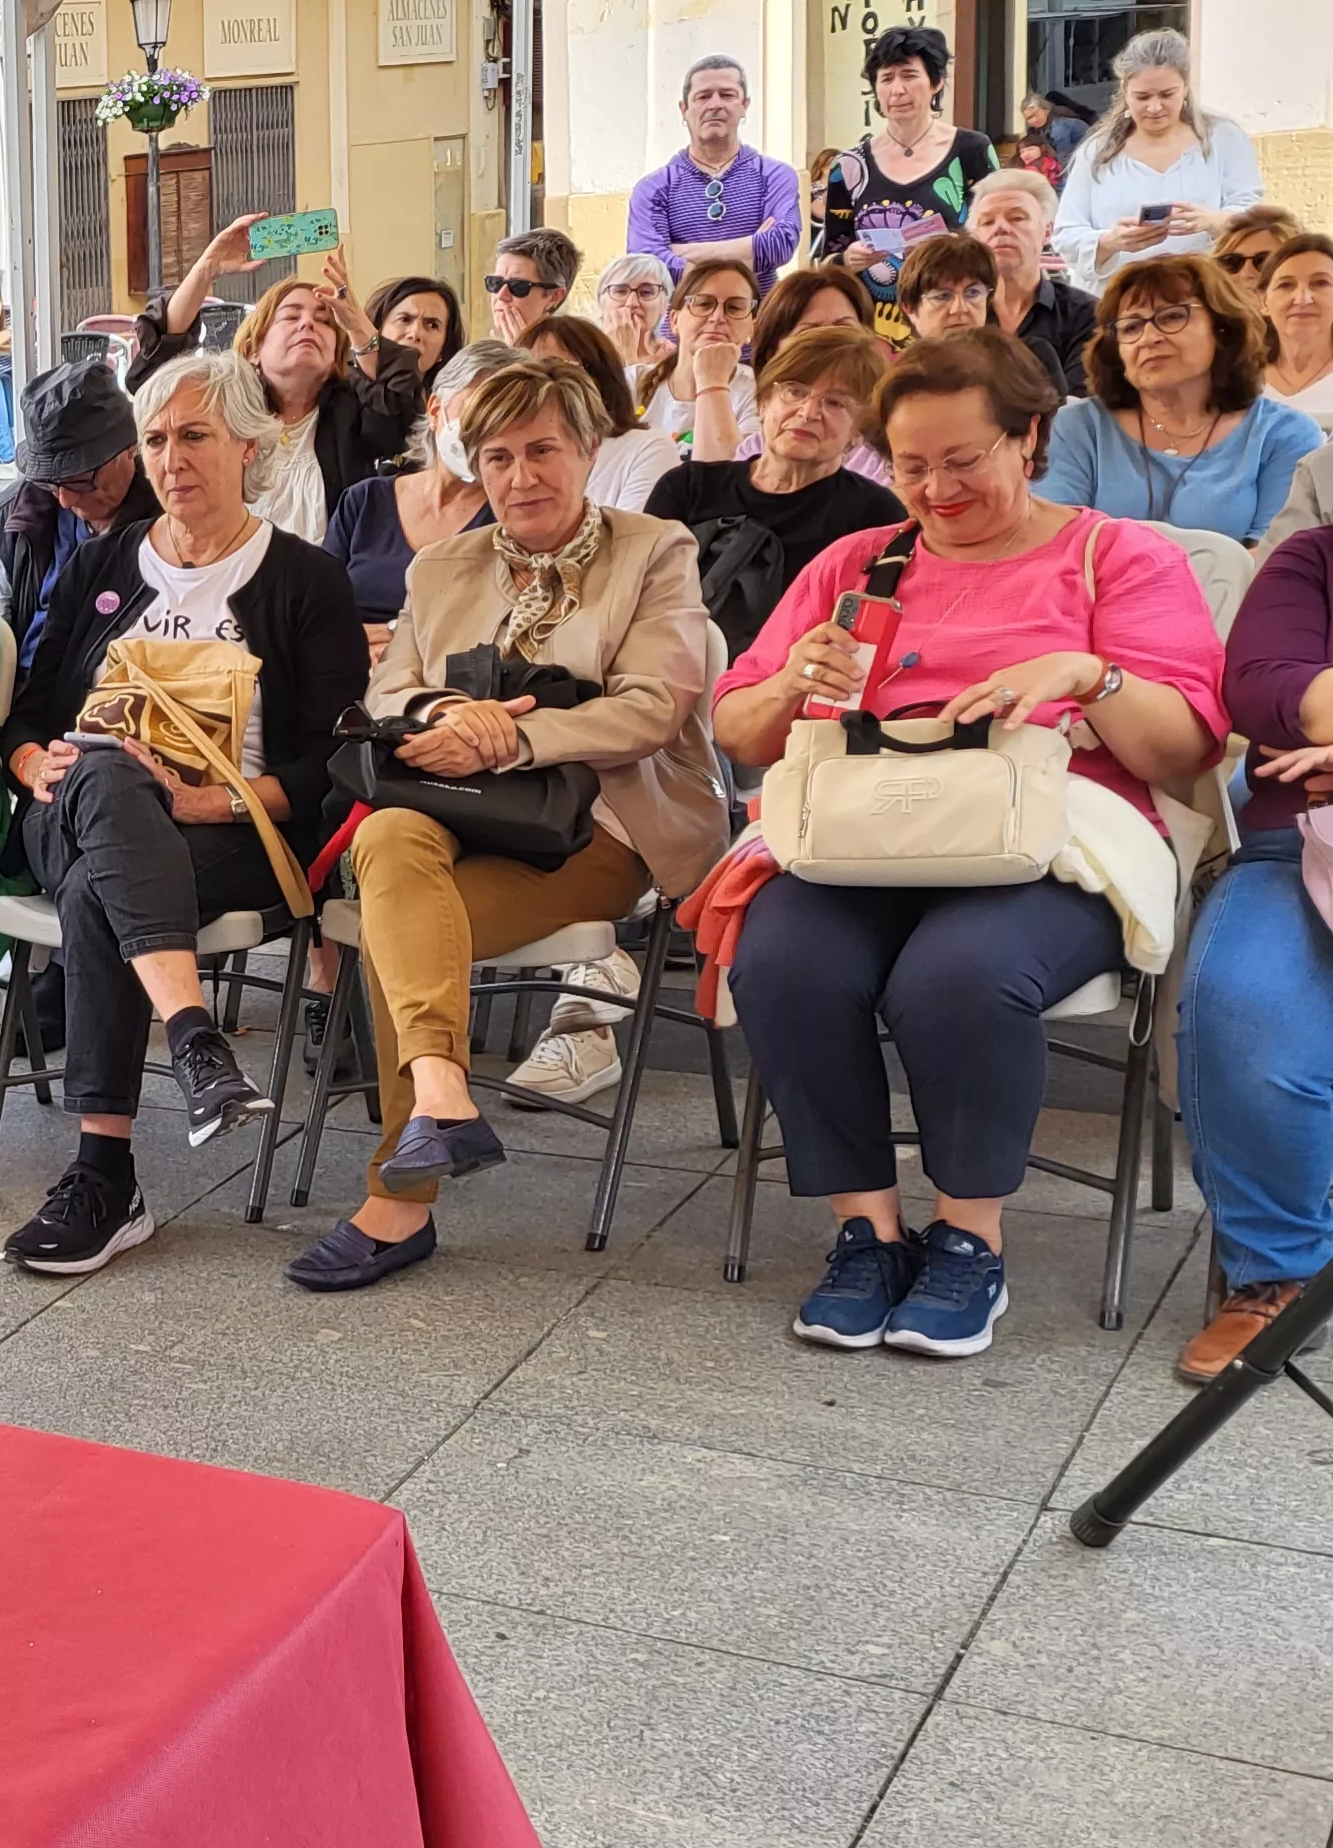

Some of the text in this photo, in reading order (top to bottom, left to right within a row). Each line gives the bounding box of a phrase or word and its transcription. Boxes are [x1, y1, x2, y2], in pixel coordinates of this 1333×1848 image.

[386, 0, 447, 21] ALMACENES
[220, 17, 280, 44] MONREAL
[392, 23, 443, 48] SAN JUAN
